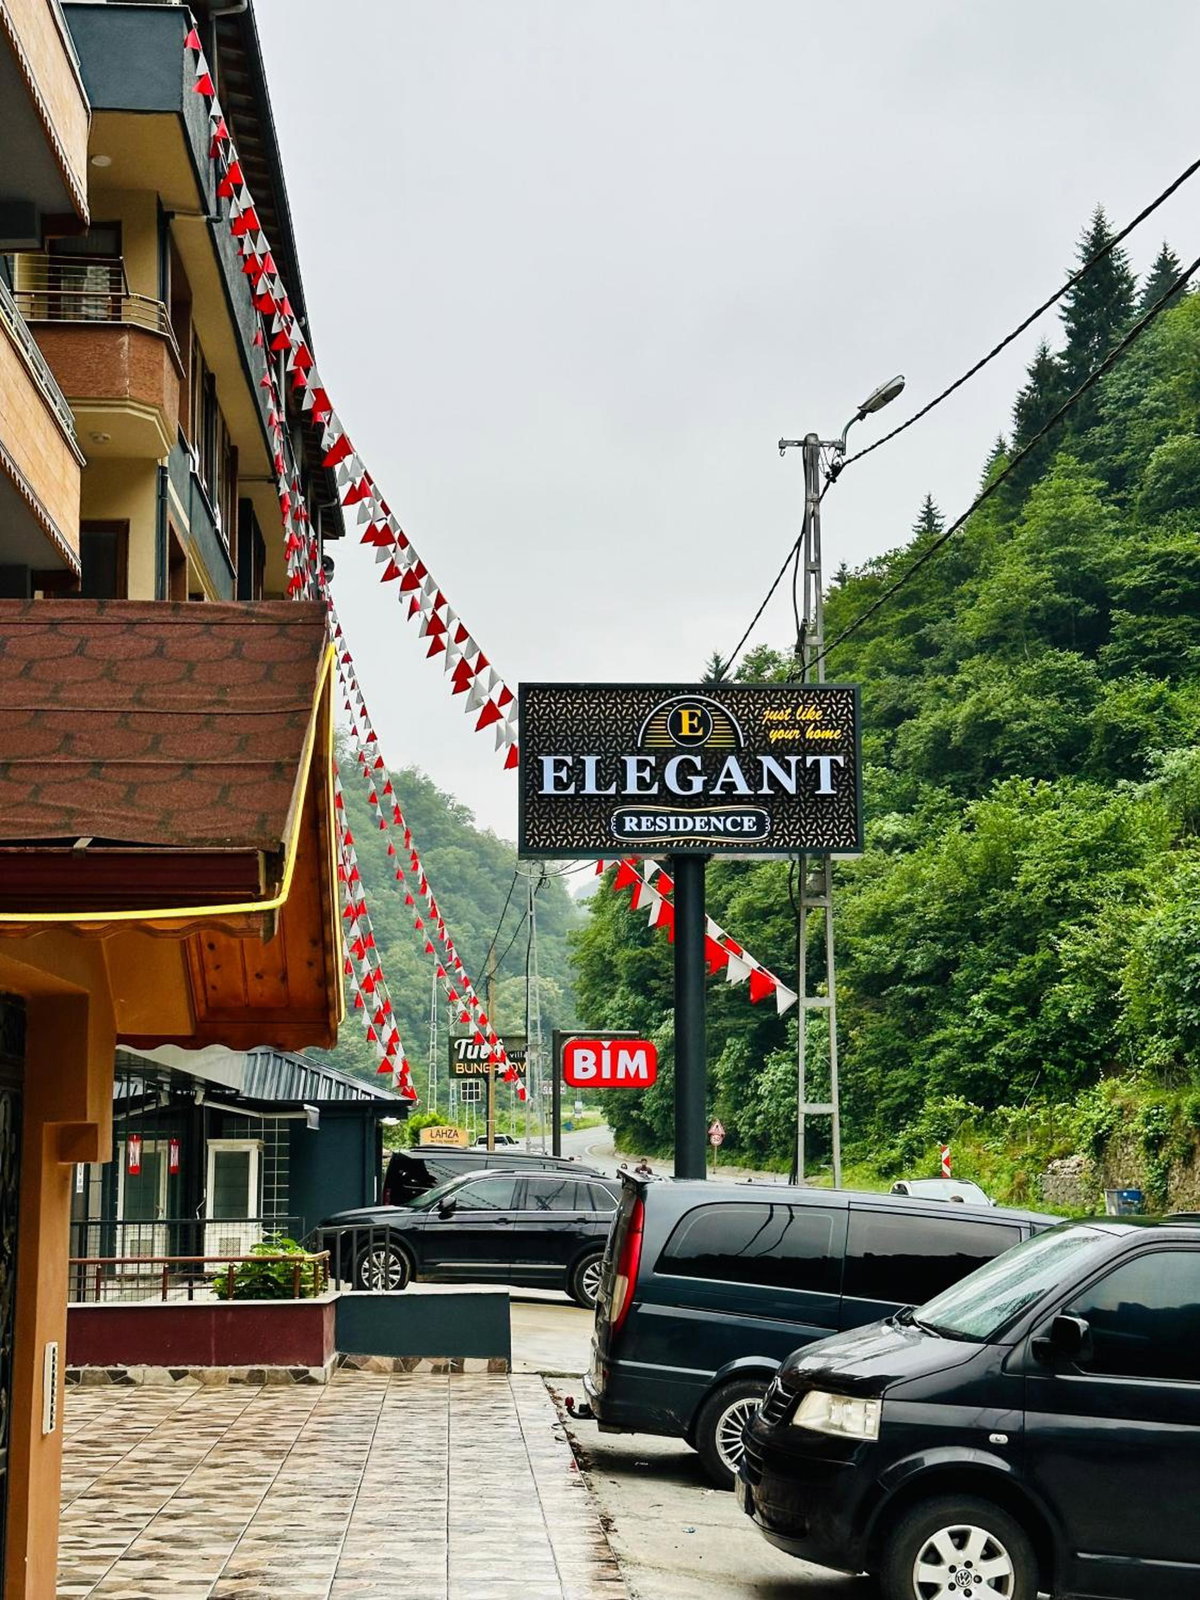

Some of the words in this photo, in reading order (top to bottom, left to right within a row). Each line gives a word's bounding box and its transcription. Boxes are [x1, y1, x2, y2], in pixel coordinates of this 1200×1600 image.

[678, 709, 704, 737] E
[762, 706, 792, 725] just
[796, 703, 823, 721] like
[769, 728, 801, 744] your
[805, 722, 842, 740] home
[538, 754, 845, 796] ELEGANT
[623, 816, 757, 833] RESIDENCE
[430, 1129, 459, 1139] LAHZA
